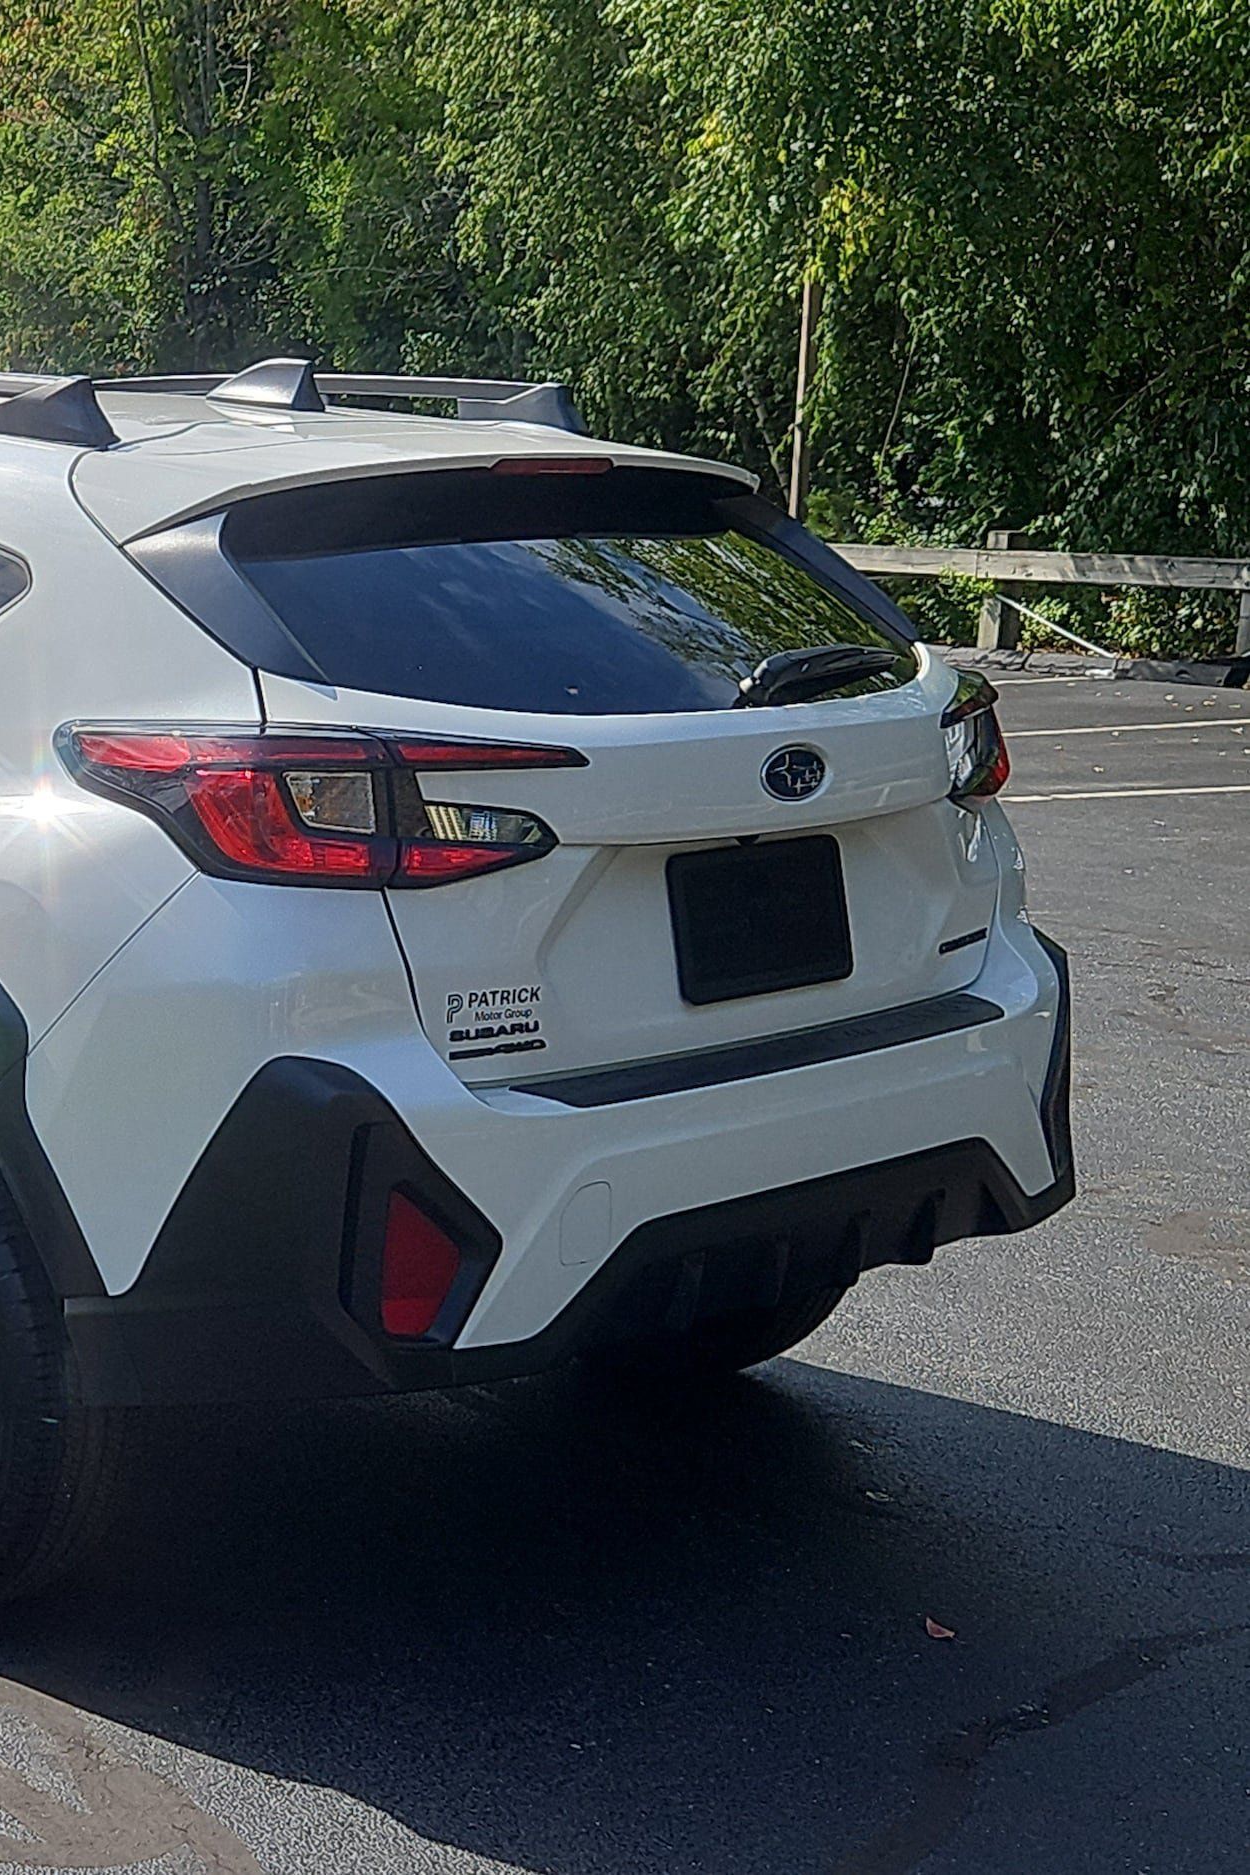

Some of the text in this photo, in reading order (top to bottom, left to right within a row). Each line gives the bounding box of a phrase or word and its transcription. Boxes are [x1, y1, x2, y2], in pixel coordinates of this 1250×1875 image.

[468, 986, 541, 1009] PATRICK
[475, 1008, 533, 1022] Motor Group
[449, 1020, 540, 1042] SUBARU
